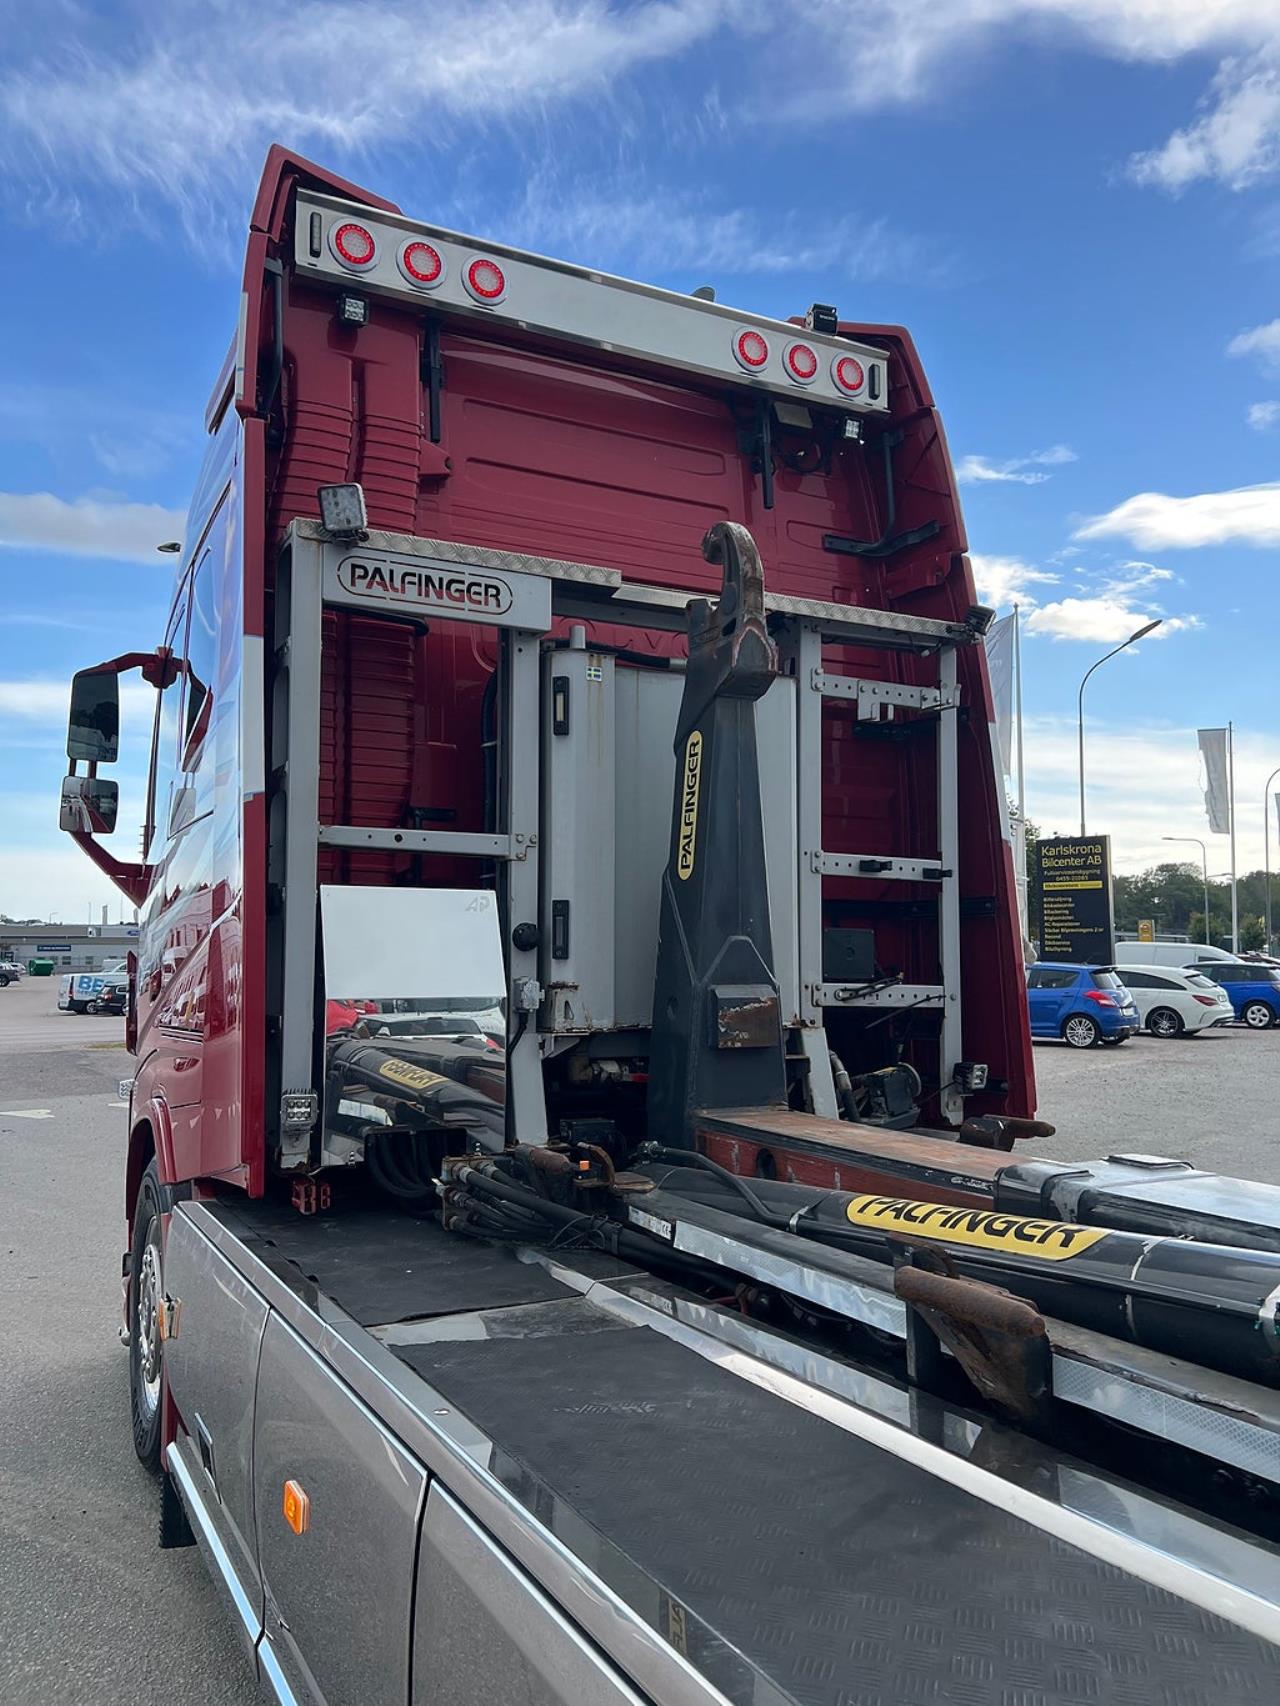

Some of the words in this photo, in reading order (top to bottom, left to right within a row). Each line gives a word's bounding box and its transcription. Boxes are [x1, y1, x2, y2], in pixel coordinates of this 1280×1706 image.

[350, 563, 501, 608] PALFINGER
[680, 740, 700, 870] PALFINGER
[1041, 844, 1102, 856] Karlskrona
[1041, 857, 1085, 868] Bilcenter
[1087, 855, 1102, 865] AB
[857, 1196, 1088, 1248] PALFINGER
